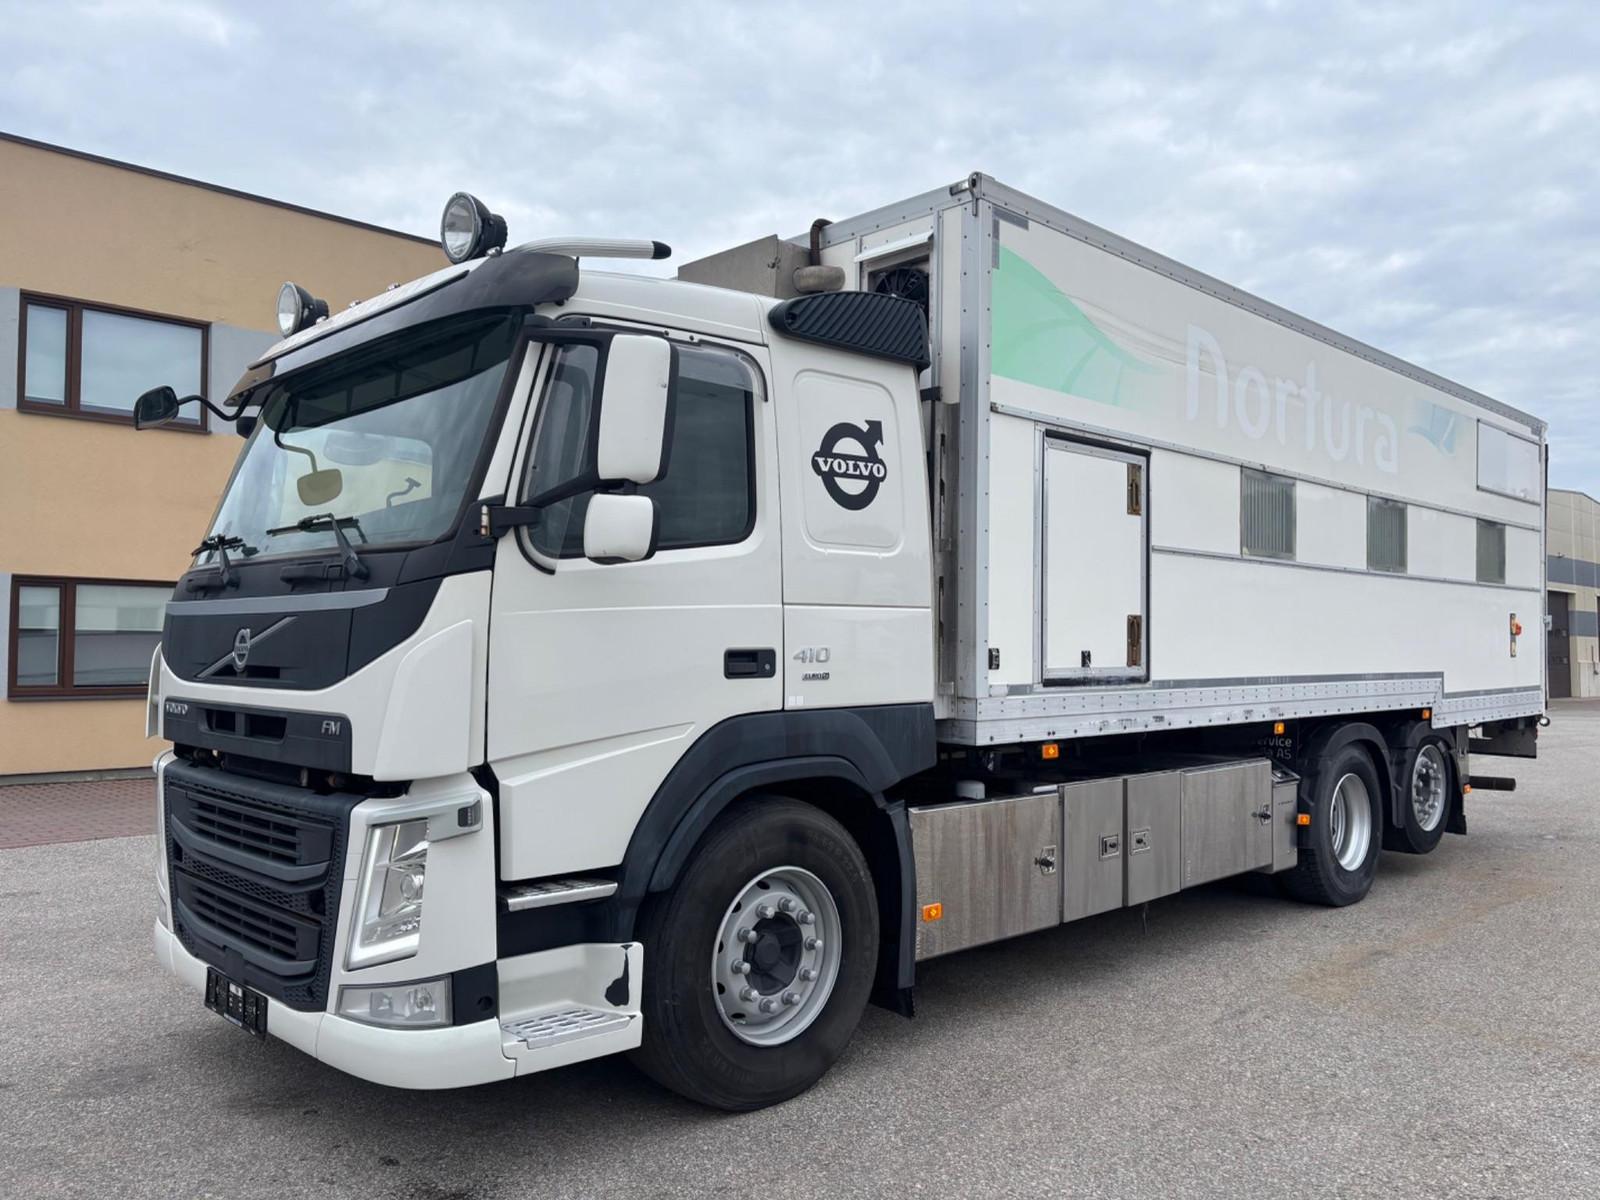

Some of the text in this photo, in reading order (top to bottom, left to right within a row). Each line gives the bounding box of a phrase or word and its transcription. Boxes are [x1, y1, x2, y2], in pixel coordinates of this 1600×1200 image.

[813, 456, 885, 478] VOLVO
[792, 646, 831, 664] 410
[321, 720, 341, 735] FM
